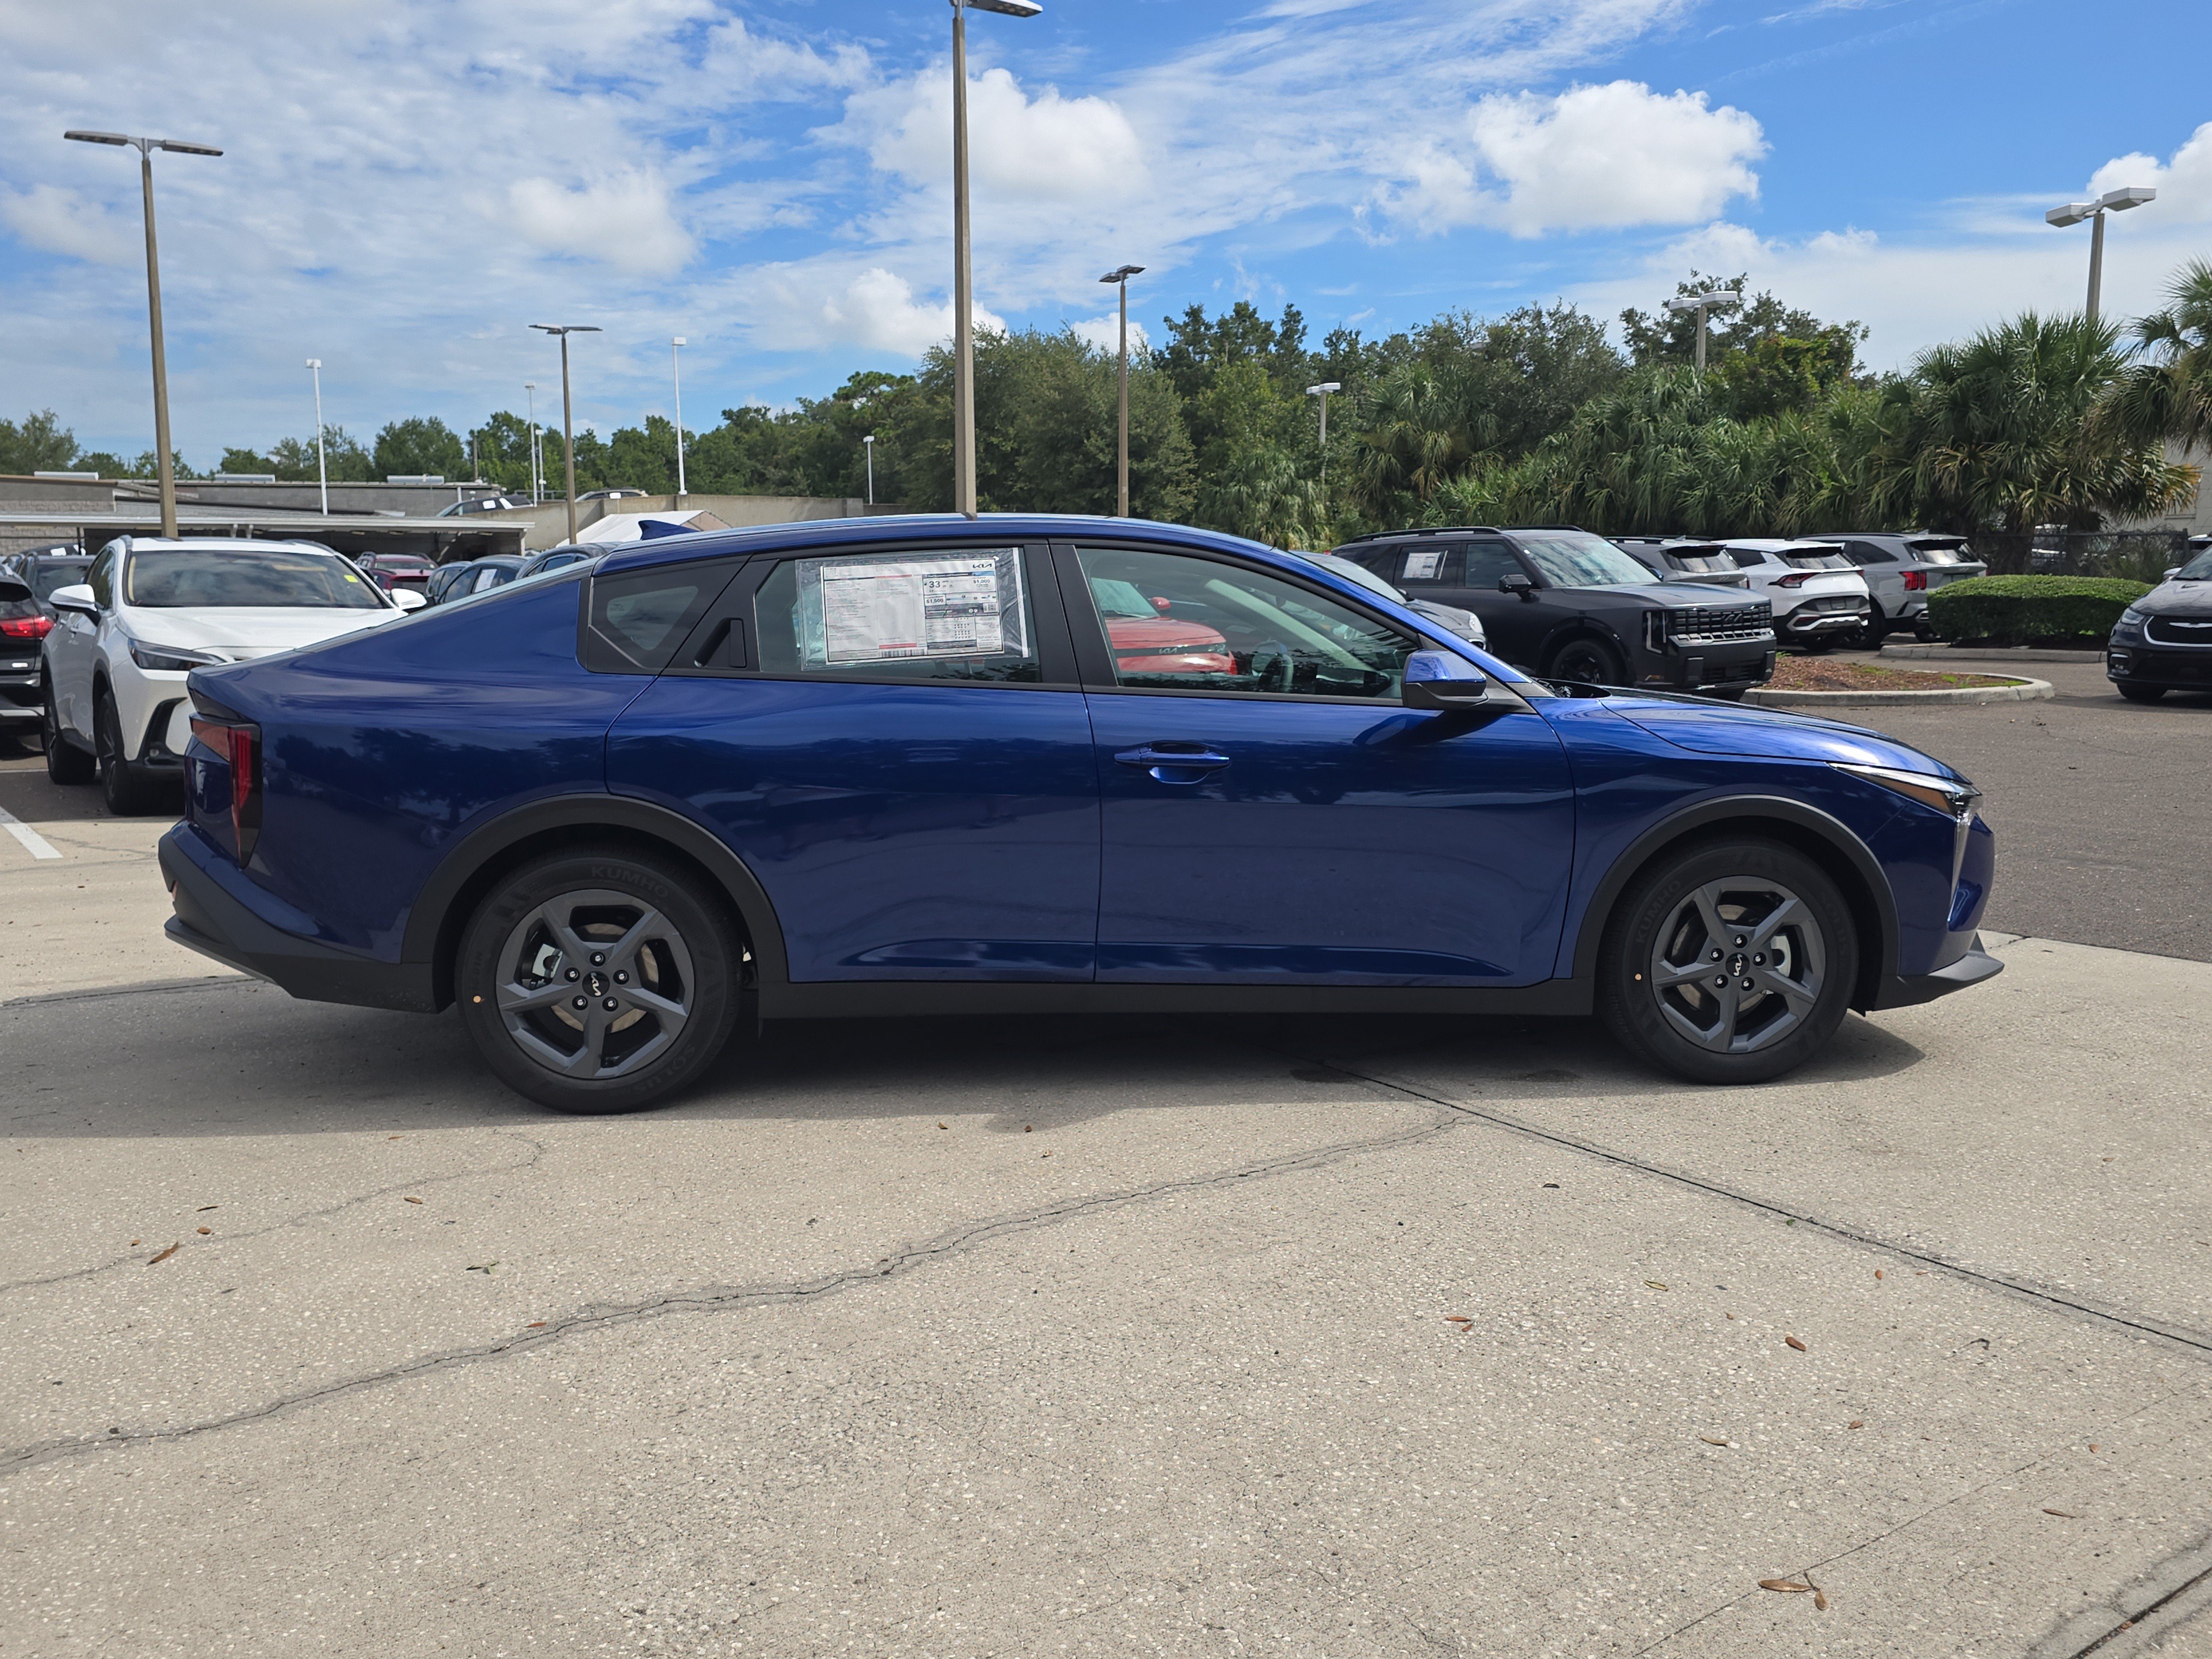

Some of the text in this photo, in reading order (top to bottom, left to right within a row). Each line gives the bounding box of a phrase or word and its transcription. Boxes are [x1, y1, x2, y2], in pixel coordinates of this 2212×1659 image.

[591, 866, 668, 898] KUMHO
[1636, 880, 1681, 944] KUMHO
[1733, 954, 1743, 976] KIA
[591, 972, 601, 996] KIA
